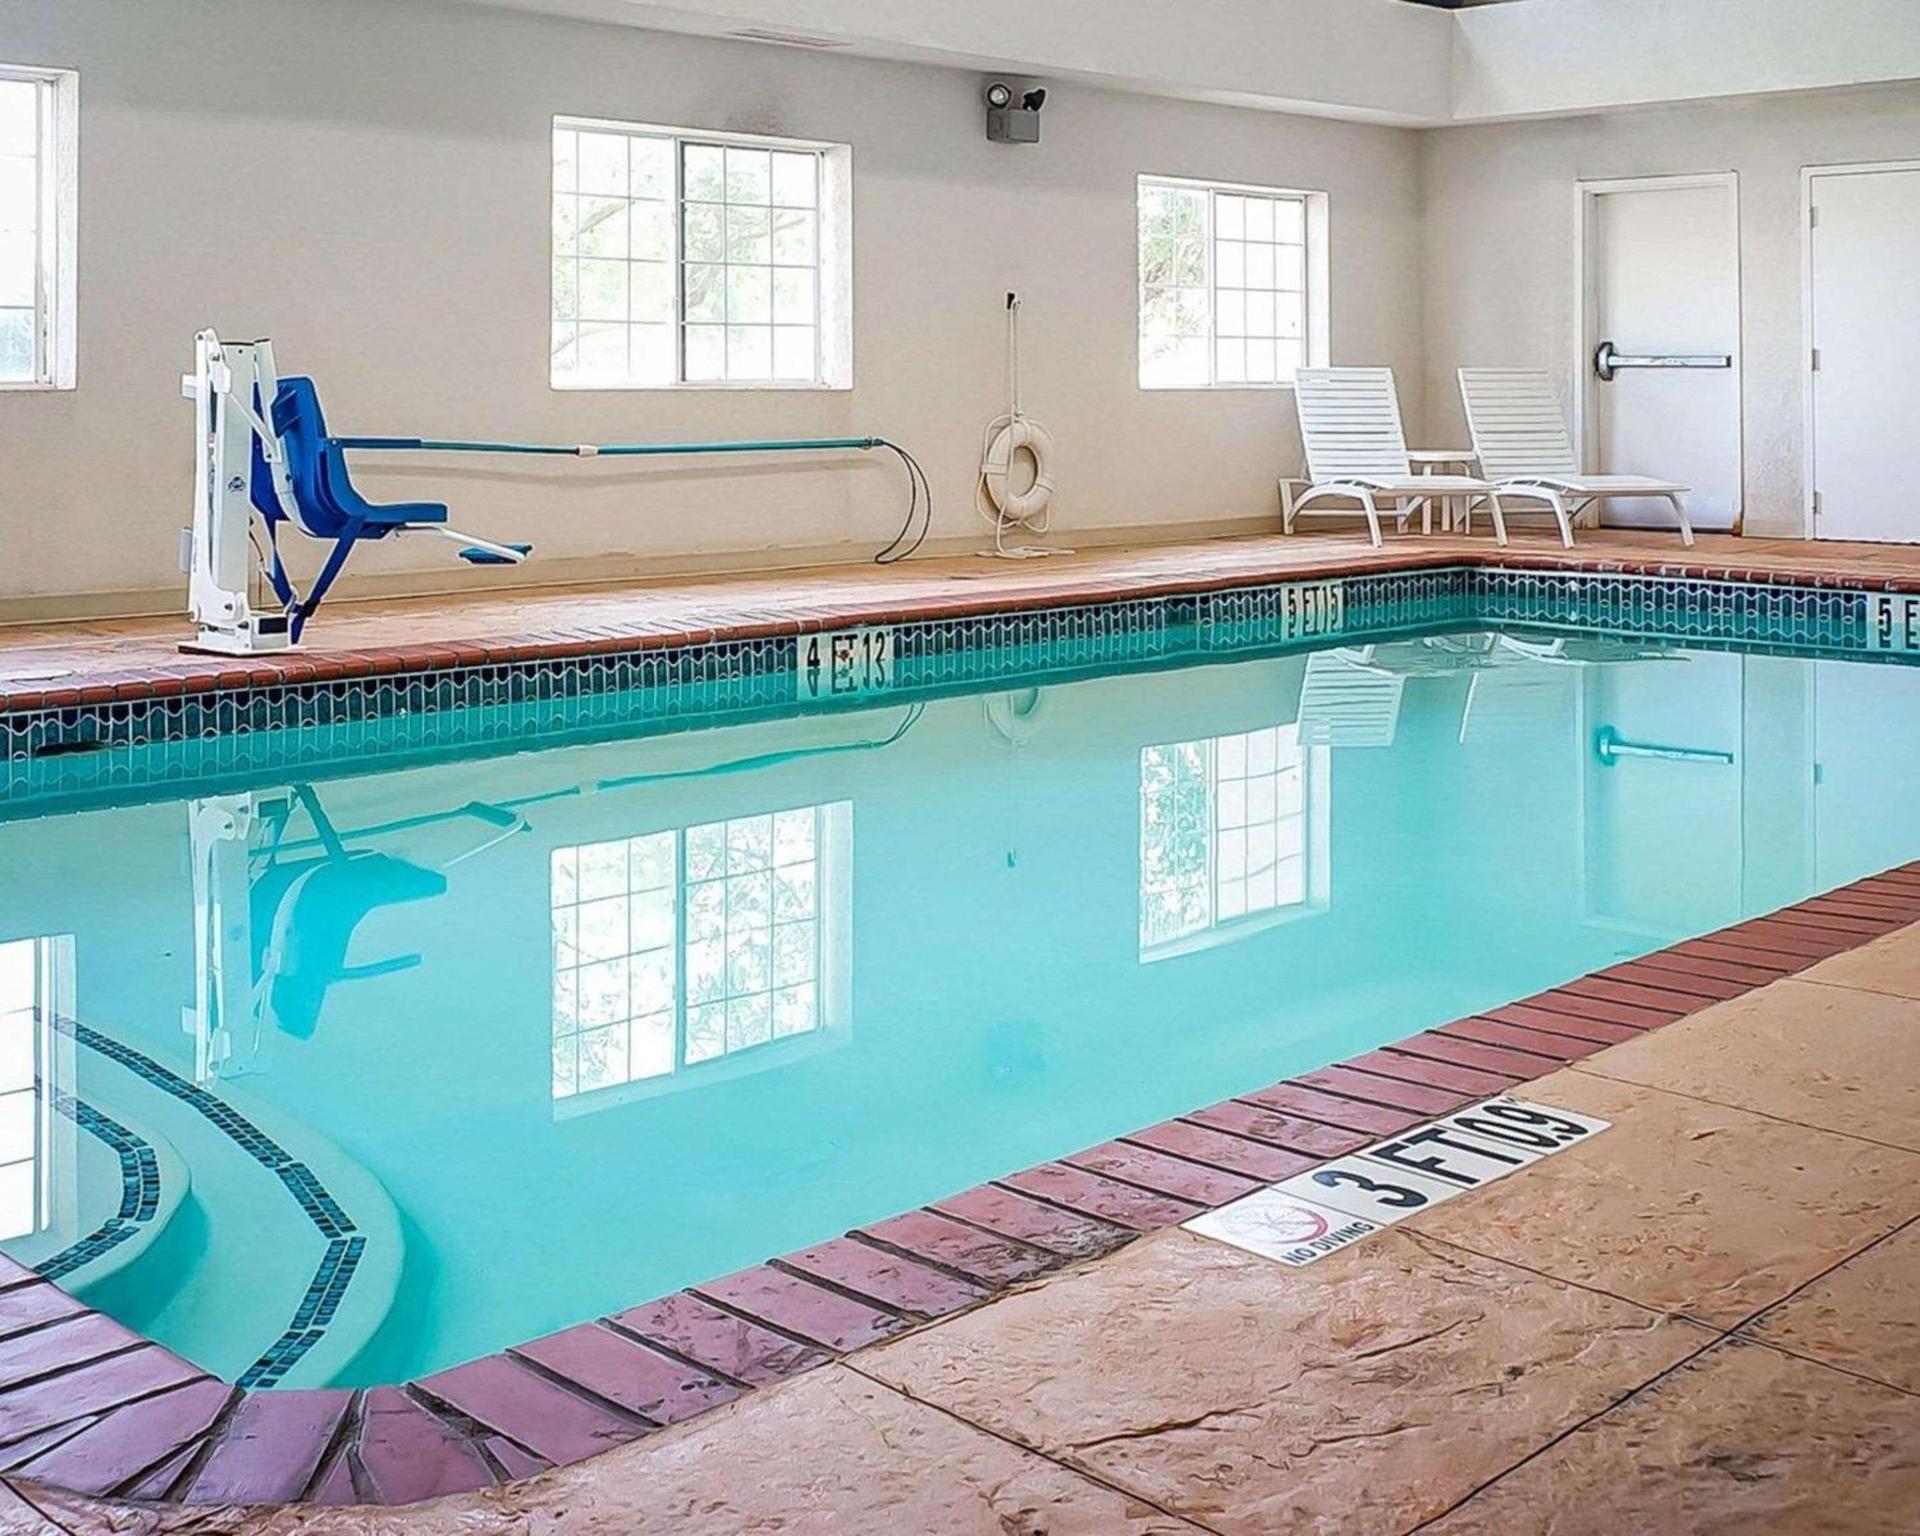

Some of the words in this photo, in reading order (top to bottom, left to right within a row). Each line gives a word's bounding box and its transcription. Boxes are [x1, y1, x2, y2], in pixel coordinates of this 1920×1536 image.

[806, 636, 821, 669] 4
[1368, 1127, 1525, 1185] FT
[1311, 1170, 1428, 1208] 3
[1280, 1247, 1318, 1265] NO
[1308, 1221, 1376, 1252] DIVING
